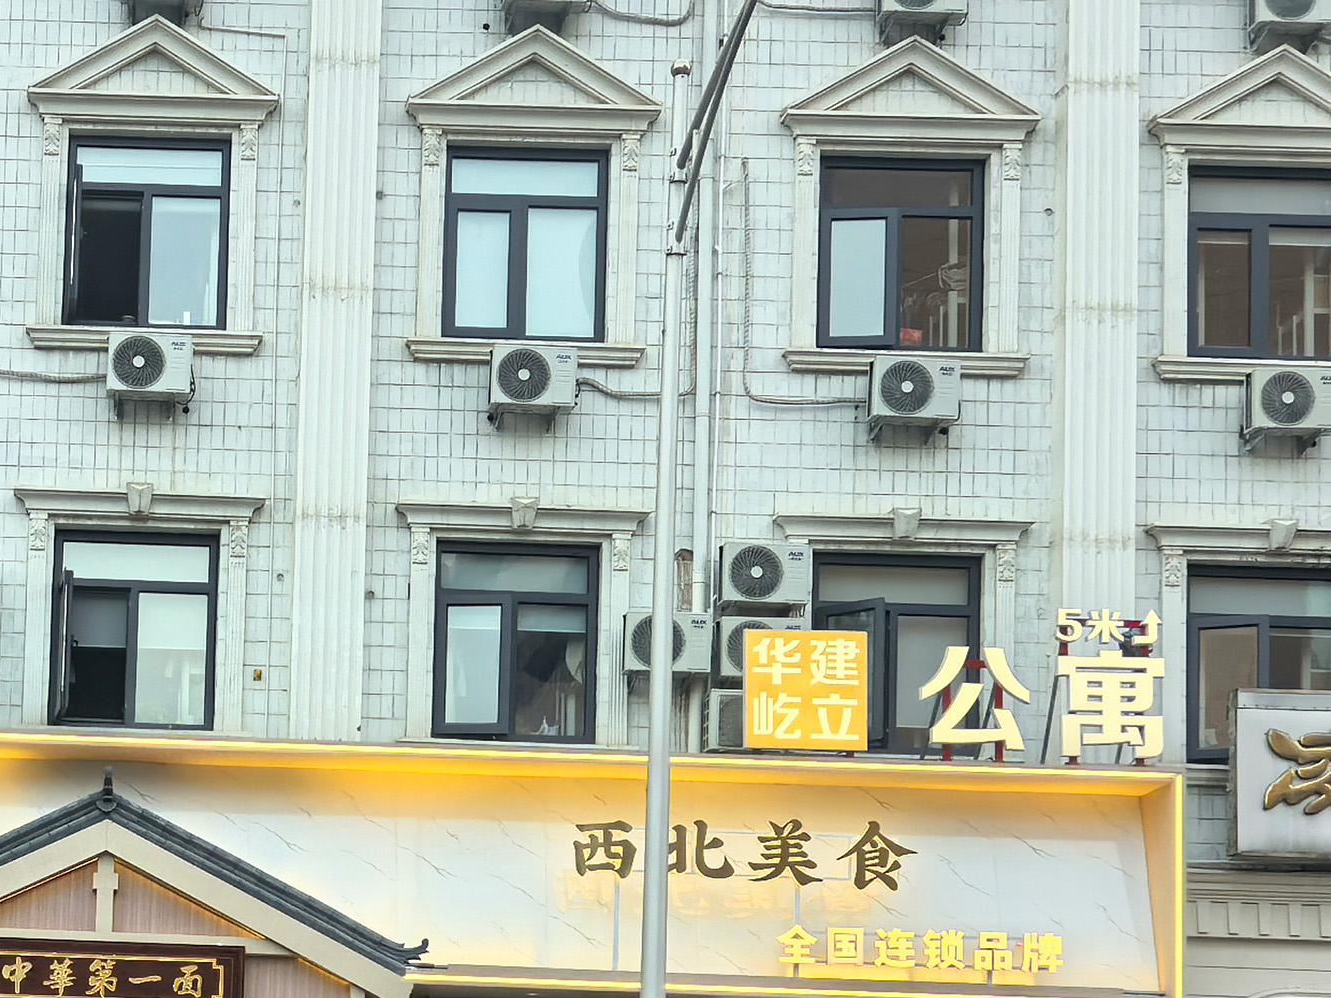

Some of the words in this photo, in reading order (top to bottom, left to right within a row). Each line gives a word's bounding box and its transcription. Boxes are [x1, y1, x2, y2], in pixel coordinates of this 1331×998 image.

[1056, 608, 1124, 643] 5米
[918, 646, 1166, 759] 公寓
[572, 818, 918, 892] 西北美食
[775, 922, 1065, 975] 全国连锁品牌
